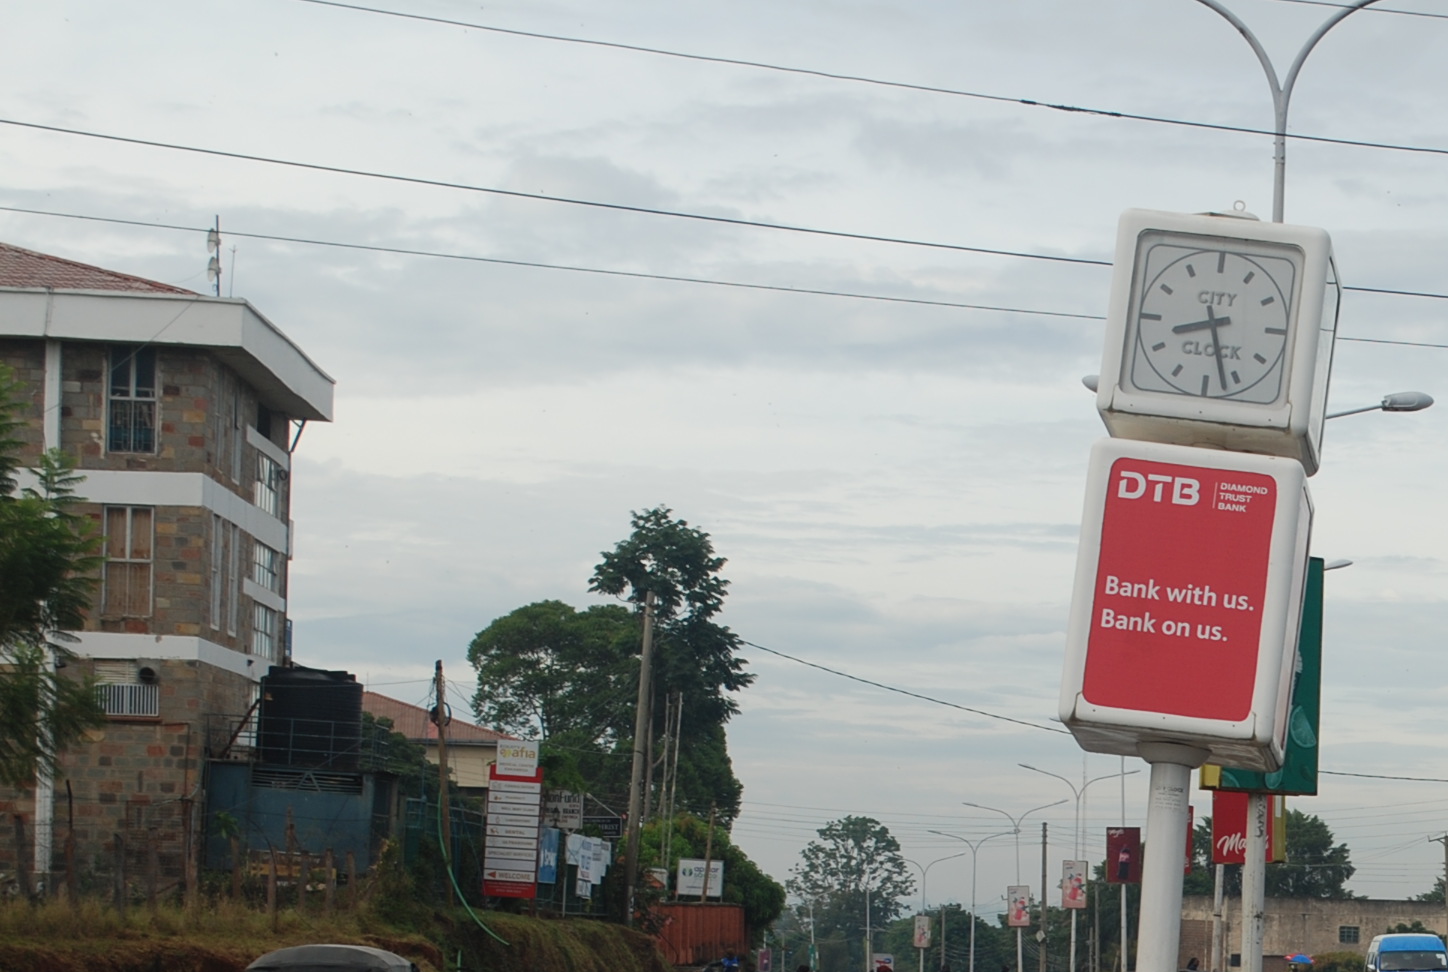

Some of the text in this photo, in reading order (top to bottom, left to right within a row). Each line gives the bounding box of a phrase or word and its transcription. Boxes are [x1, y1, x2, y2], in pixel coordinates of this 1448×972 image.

[1197, 289, 1238, 308] CITY
[1181, 340, 1242, 361] CLOCK
[1117, 471, 1200, 506] DTB
[1219, 482, 1268, 495] DIAMOND
[1219, 492, 1252, 503] TRUST
[1217, 502, 1247, 513] BANK
[1105, 575, 1255, 612] Bank with us.
[1100, 608, 1228, 642] Bank on us.
[498, 872, 530, 880] WELCOME
